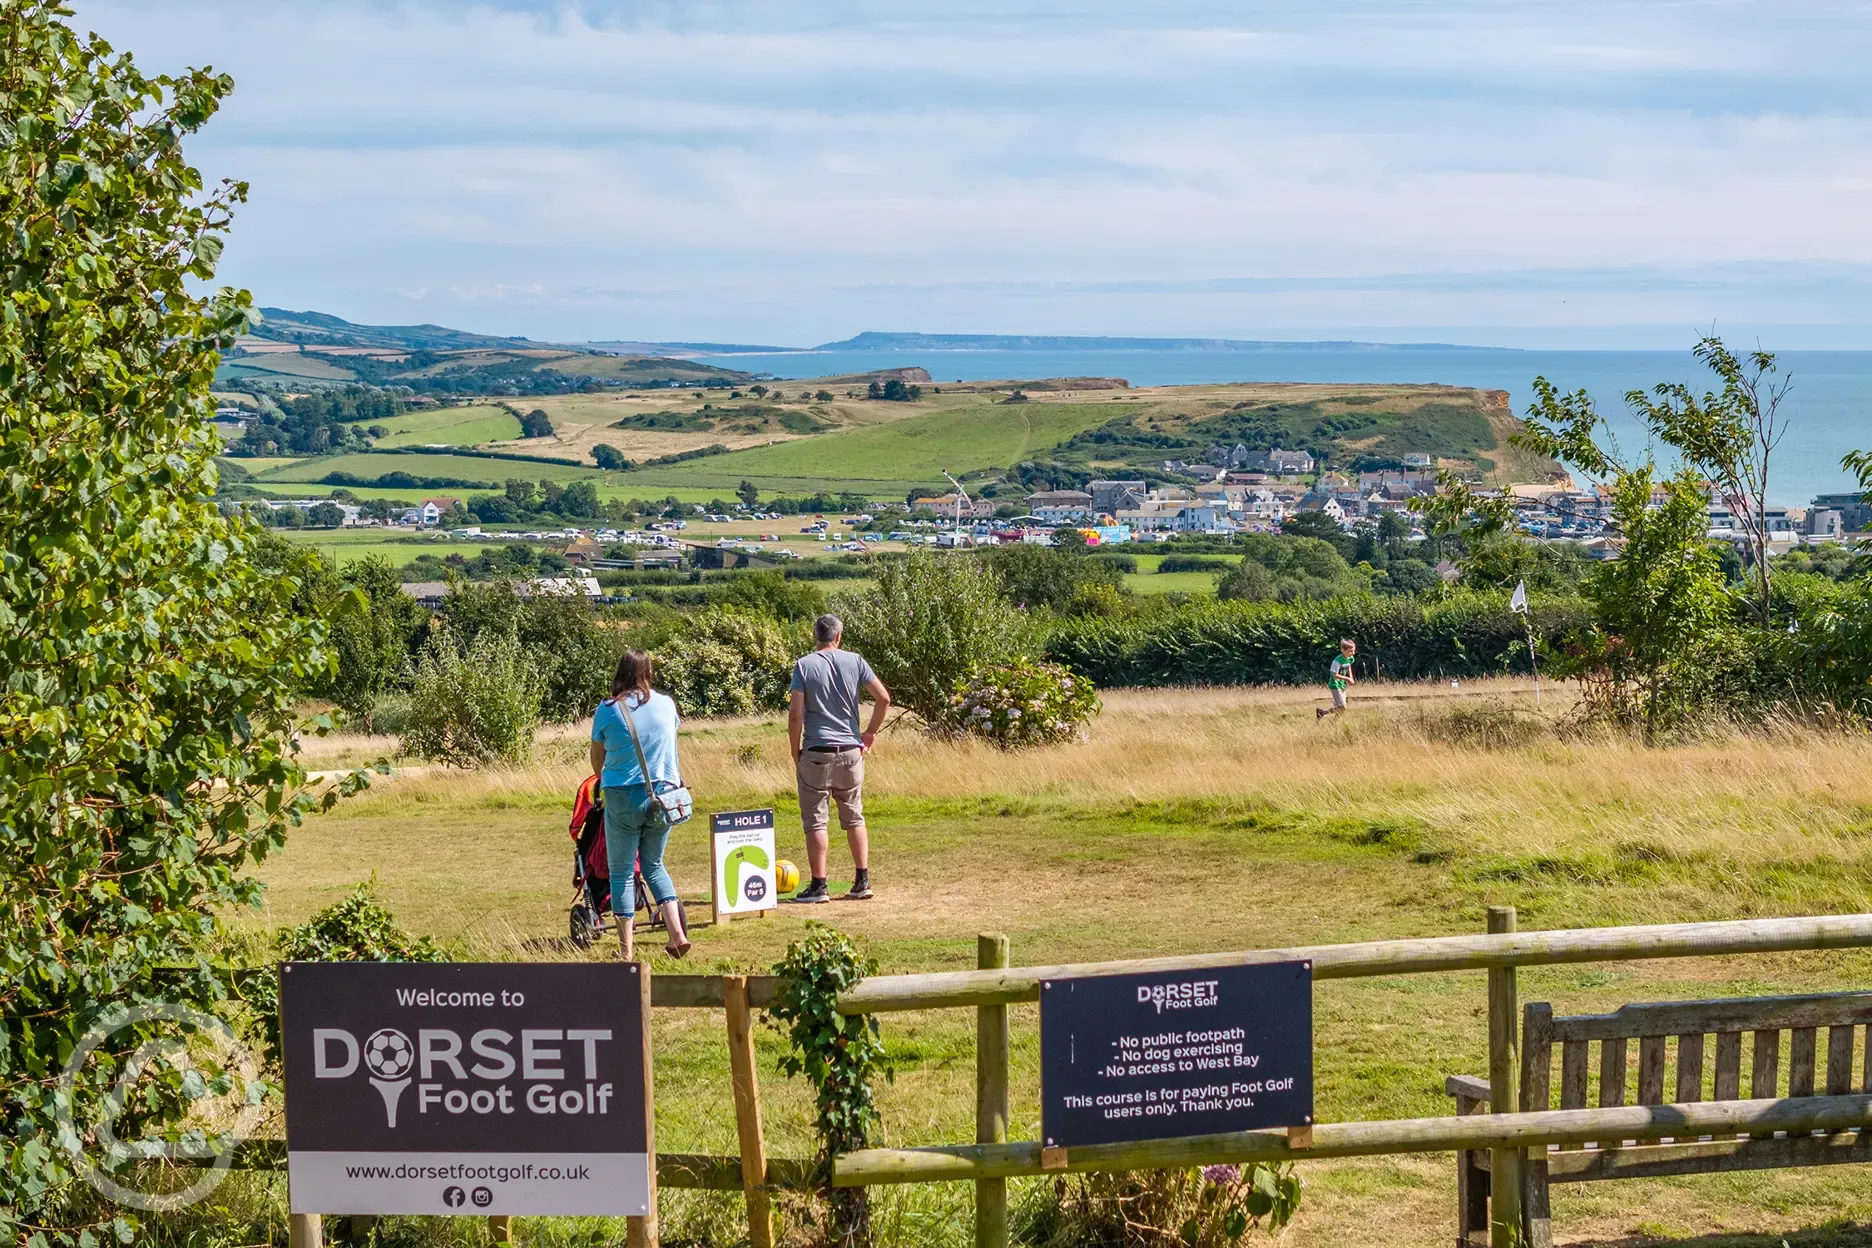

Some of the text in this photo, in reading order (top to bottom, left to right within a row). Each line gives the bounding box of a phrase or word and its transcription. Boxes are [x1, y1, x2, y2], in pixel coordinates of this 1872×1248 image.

[735, 816, 760, 826] HOLE
[762, 815, 766, 823] 1
[747, 889, 759, 897] Par
[396, 988, 525, 1006] Welcome to
[1137, 981, 1219, 1003] DORSET
[1166, 996, 1219, 1009] Foot Golf
[1120, 1036, 1139, 1048] No
[1142, 1032, 1183, 1050] public
[1186, 1027, 1245, 1045] footpath
[313, 1028, 613, 1080] DORSET
[1123, 1050, 1141, 1062] No
[1144, 1048, 1170, 1061] dog
[1174, 1042, 1243, 1058] exercising
[1106, 1065, 1125, 1077] No
[1128, 1062, 1176, 1075] access
[1179, 1060, 1193, 1071] to
[1196, 1056, 1230, 1069] West
[1233, 1055, 1260, 1068] Bay
[418, 1083, 613, 1114] Foot Golf
[1064, 1077, 1294, 1108] This course is for paying Foot Golf
[1104, 1097, 1254, 1119] users only. Thank you.
[346, 1164, 590, 1183] www.dorsetfootgolf.co.uk
